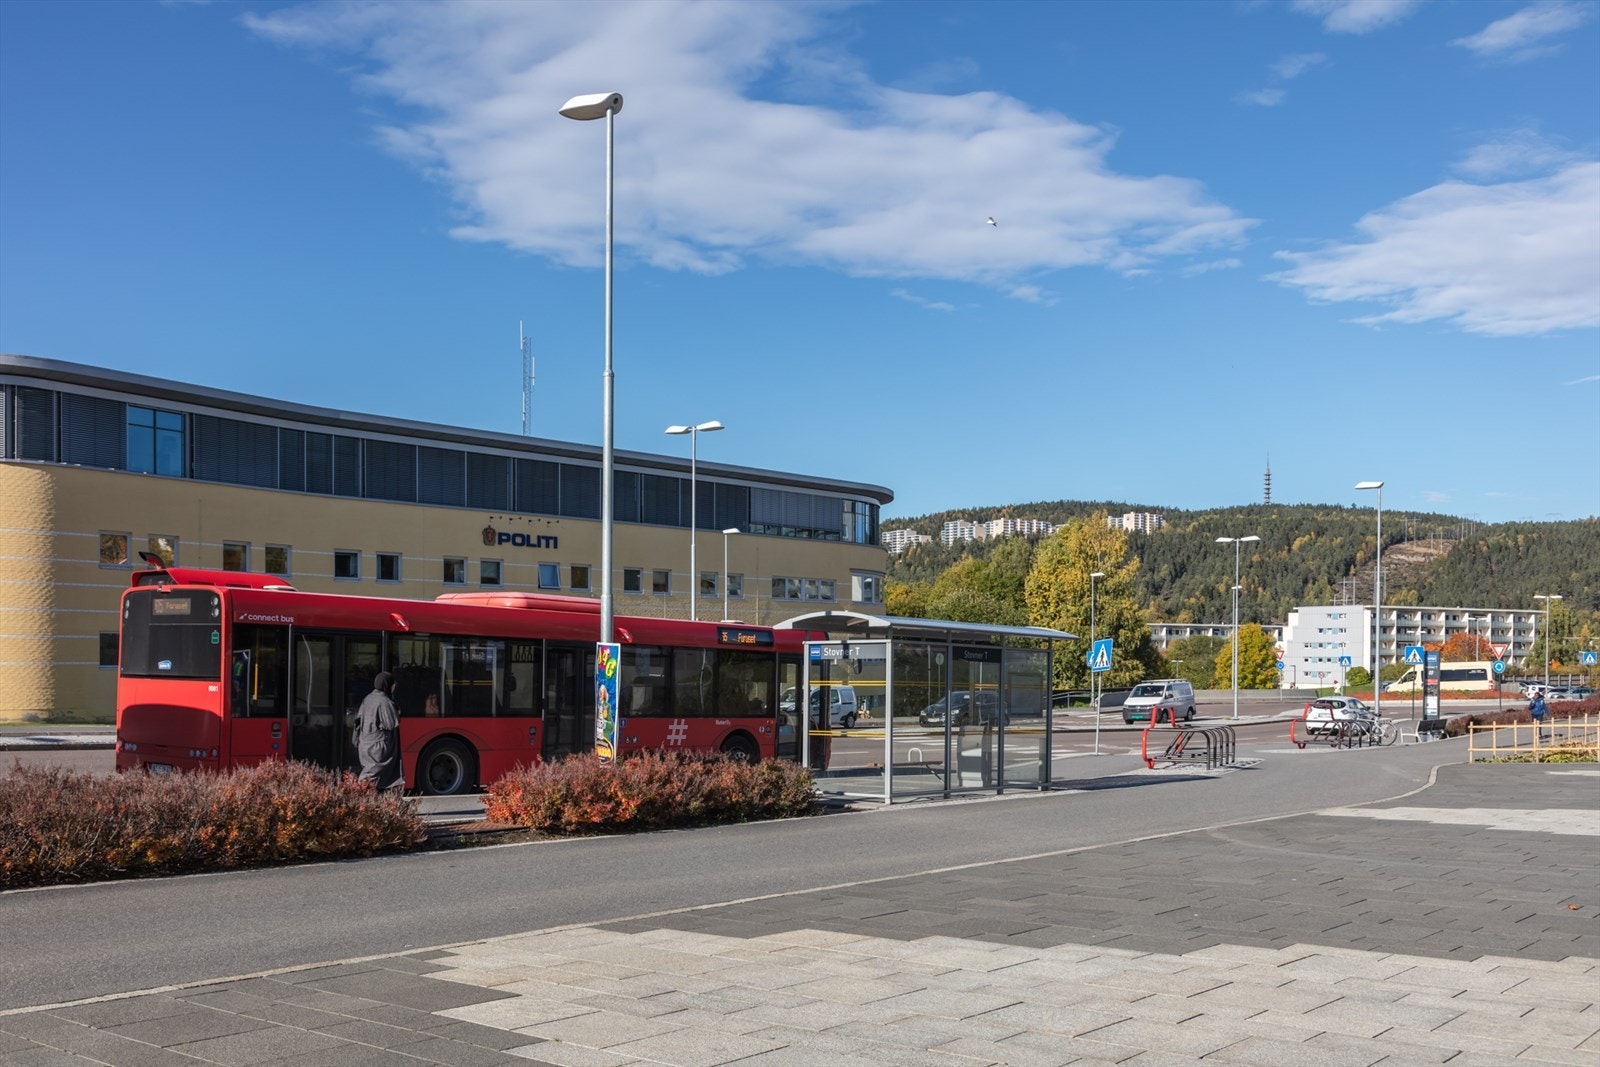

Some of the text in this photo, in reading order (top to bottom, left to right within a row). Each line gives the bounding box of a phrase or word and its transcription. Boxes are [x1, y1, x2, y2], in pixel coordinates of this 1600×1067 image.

[498, 532, 558, 549] POLITI
[248, 614, 294, 623] connect bus
[823, 647, 860, 656] Stovner T
